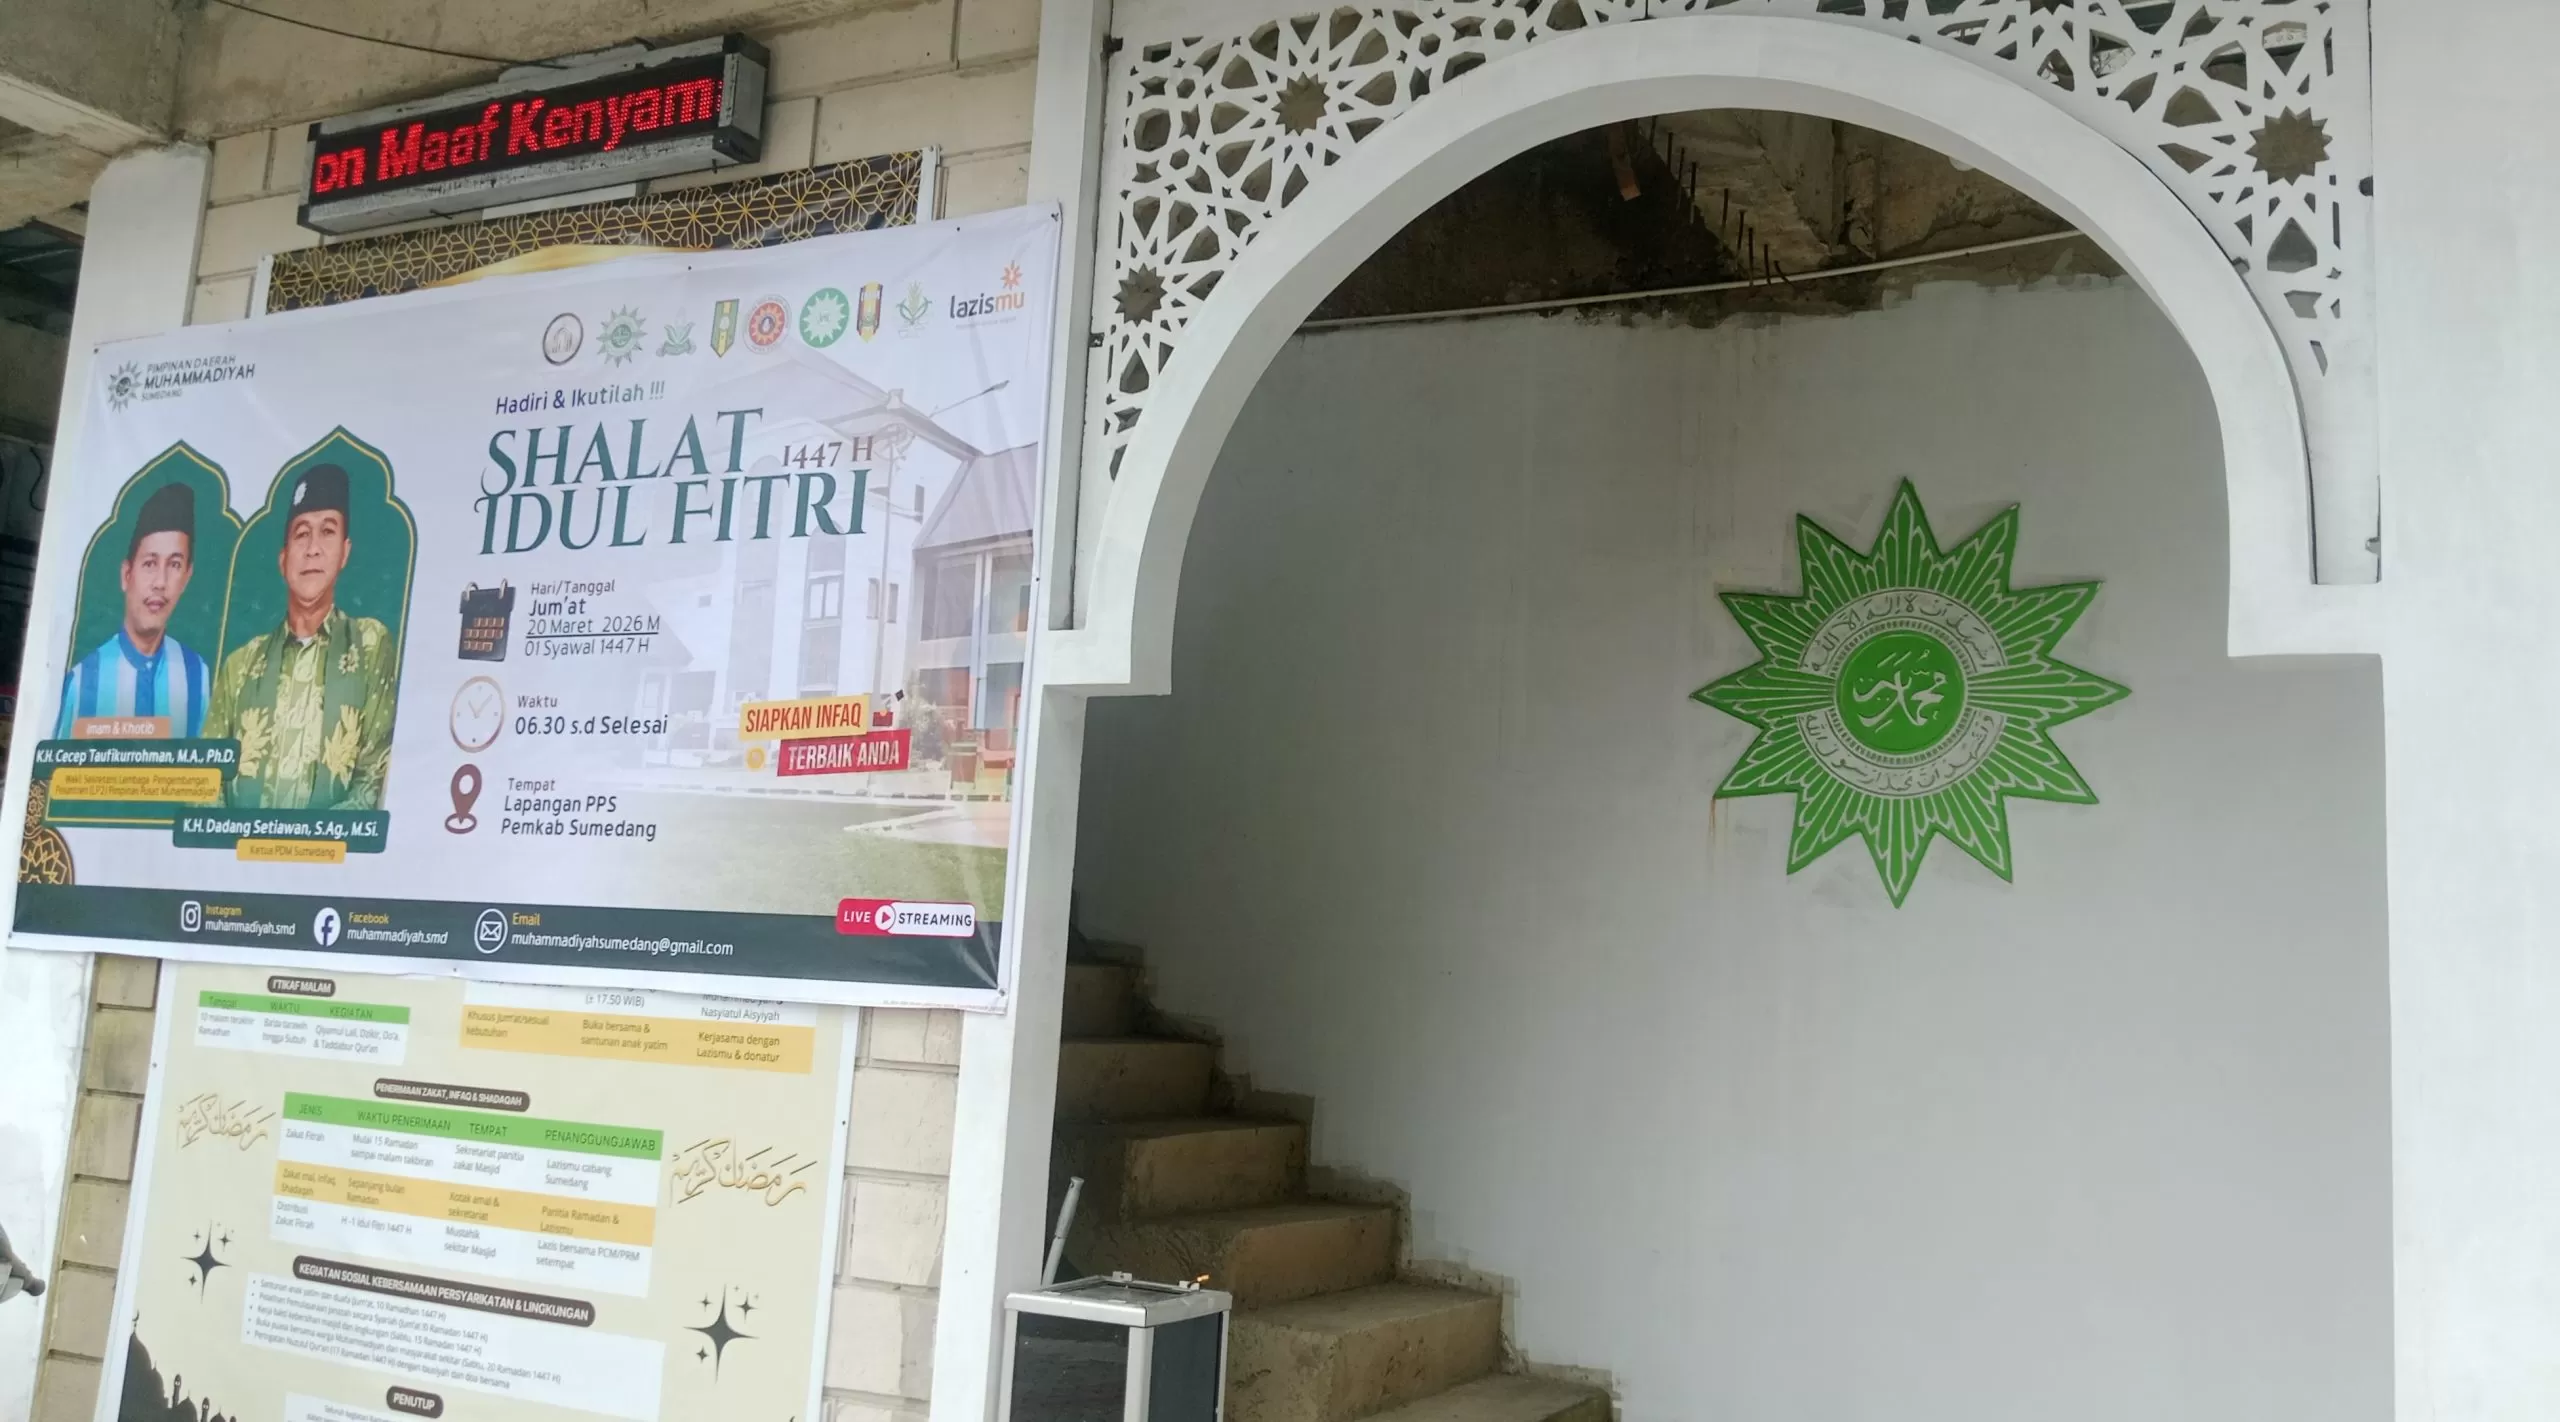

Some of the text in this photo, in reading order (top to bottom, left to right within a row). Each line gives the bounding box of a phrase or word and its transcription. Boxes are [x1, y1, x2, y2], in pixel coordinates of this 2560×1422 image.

[377, 103, 503, 180] Maaf
[950, 291, 1025, 318] lazismu
[147, 355, 236, 373] PIMPINAN DAERAH
[144, 363, 255, 389] MUHAMMADIYAH
[496, 381, 665, 415] Hadiri & Ikutilah !!!
[481, 407, 763, 498] SHALAT
[782, 435, 874, 469] 1447 H
[474, 468, 872, 556] IDUL FITRI
[531, 579, 615, 598] Hari/Tanggal
[527, 615, 660, 635] 20 Maret 2026 M
[525, 638, 649, 660] 01 Syawal 1447 H
[518, 696, 558, 708] Waktu
[515, 715, 668, 734] 06.30 s.d Selesai
[746, 702, 862, 733] SIAPKAN INFAQ
[113, 722, 120, 734] &
[121, 722, 155, 735] Khotib
[55, 751, 87, 766] Cecep
[206, 751, 236, 763] Ph.D.
[788, 740, 900, 771] TERBAIK ANDA
[508, 777, 556, 794] Tempat
[504, 795, 617, 816] Lapangan PPS
[206, 818, 250, 837] Dadang
[253, 819, 312, 837] Setiawan,
[501, 818, 657, 842] Pemkab Sumedang
[205, 904, 242, 917] Instagram
[348, 911, 390, 925] Facebook
[512, 912, 541, 926] Email
[843, 910, 972, 927] LIVE STREAMING
[205, 920, 295, 936] muhammadiyah.smd
[347, 927, 448, 946] muhammadiyah.smd
[511, 932, 734, 956] muhammadiyahsumedang@gmail.com
[597, 995, 621, 1006] 17.50
[605, 1020, 641, 1032] bersama
[643, 1024, 650, 1033] &
[622, 1039, 641, 1048] anak
[643, 1040, 668, 1051] yatim
[699, 1032, 780, 1048] Kerjasama dengan
[697, 1048, 780, 1063] Lazismu & donatur
[358, 1111, 389, 1124] WAKTU
[392, 1114, 451, 1131] PENERIMAAN
[470, 1123, 508, 1137] TEMPAT
[545, 1129, 655, 1151] PENANGGUNGJAWAB
[300, 1263, 589, 1321] KEGIATAN SOSIAL KEBERSAMAAN PERSYARIKATAN & LINGKUNGAN
[393, 1392, 435, 1411] PENUTUP
